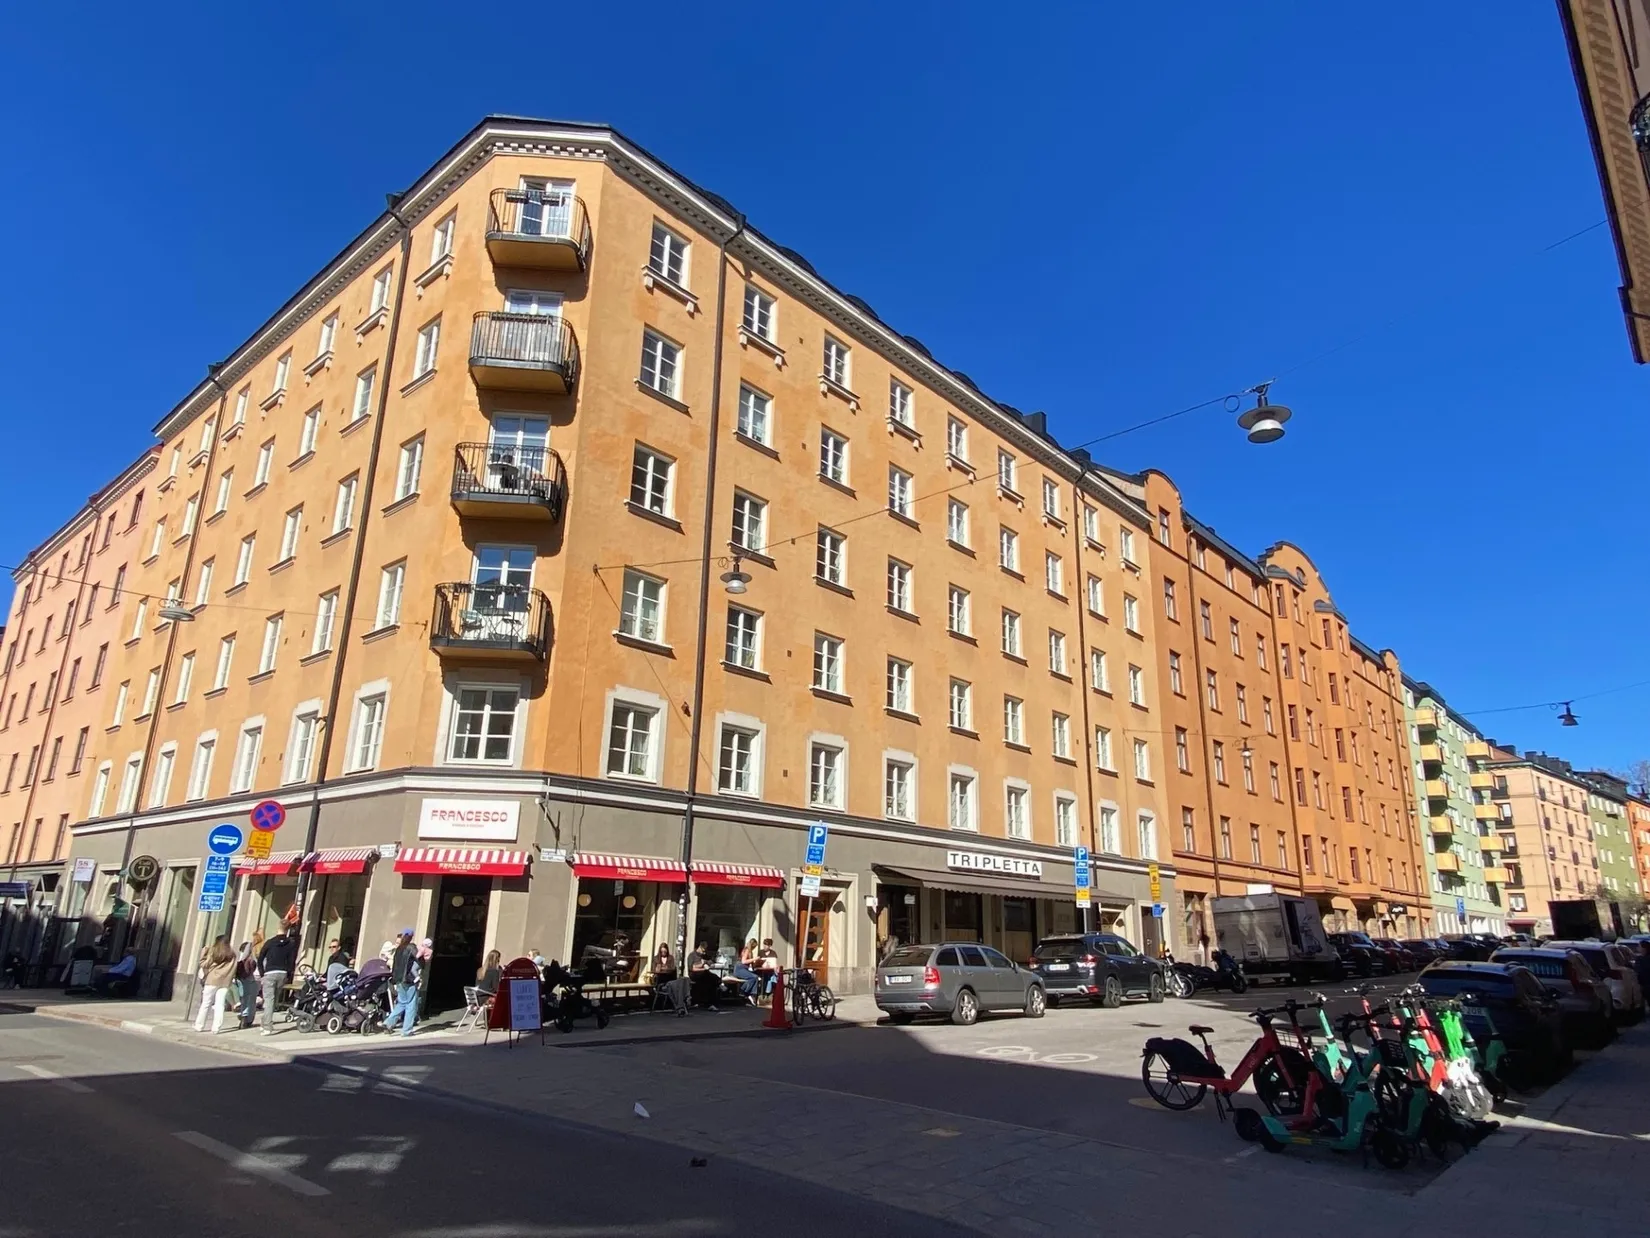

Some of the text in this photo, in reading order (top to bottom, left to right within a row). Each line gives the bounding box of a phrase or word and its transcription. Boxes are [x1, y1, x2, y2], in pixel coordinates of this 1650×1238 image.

[430, 809, 508, 823] FRANCESCO
[813, 828, 824, 842] P
[1078, 848, 1086, 859] P
[438, 863, 481, 871] FRANCESCO
[950, 853, 1040, 874] TRIPLETTA
[137, 865, 150, 878] T
